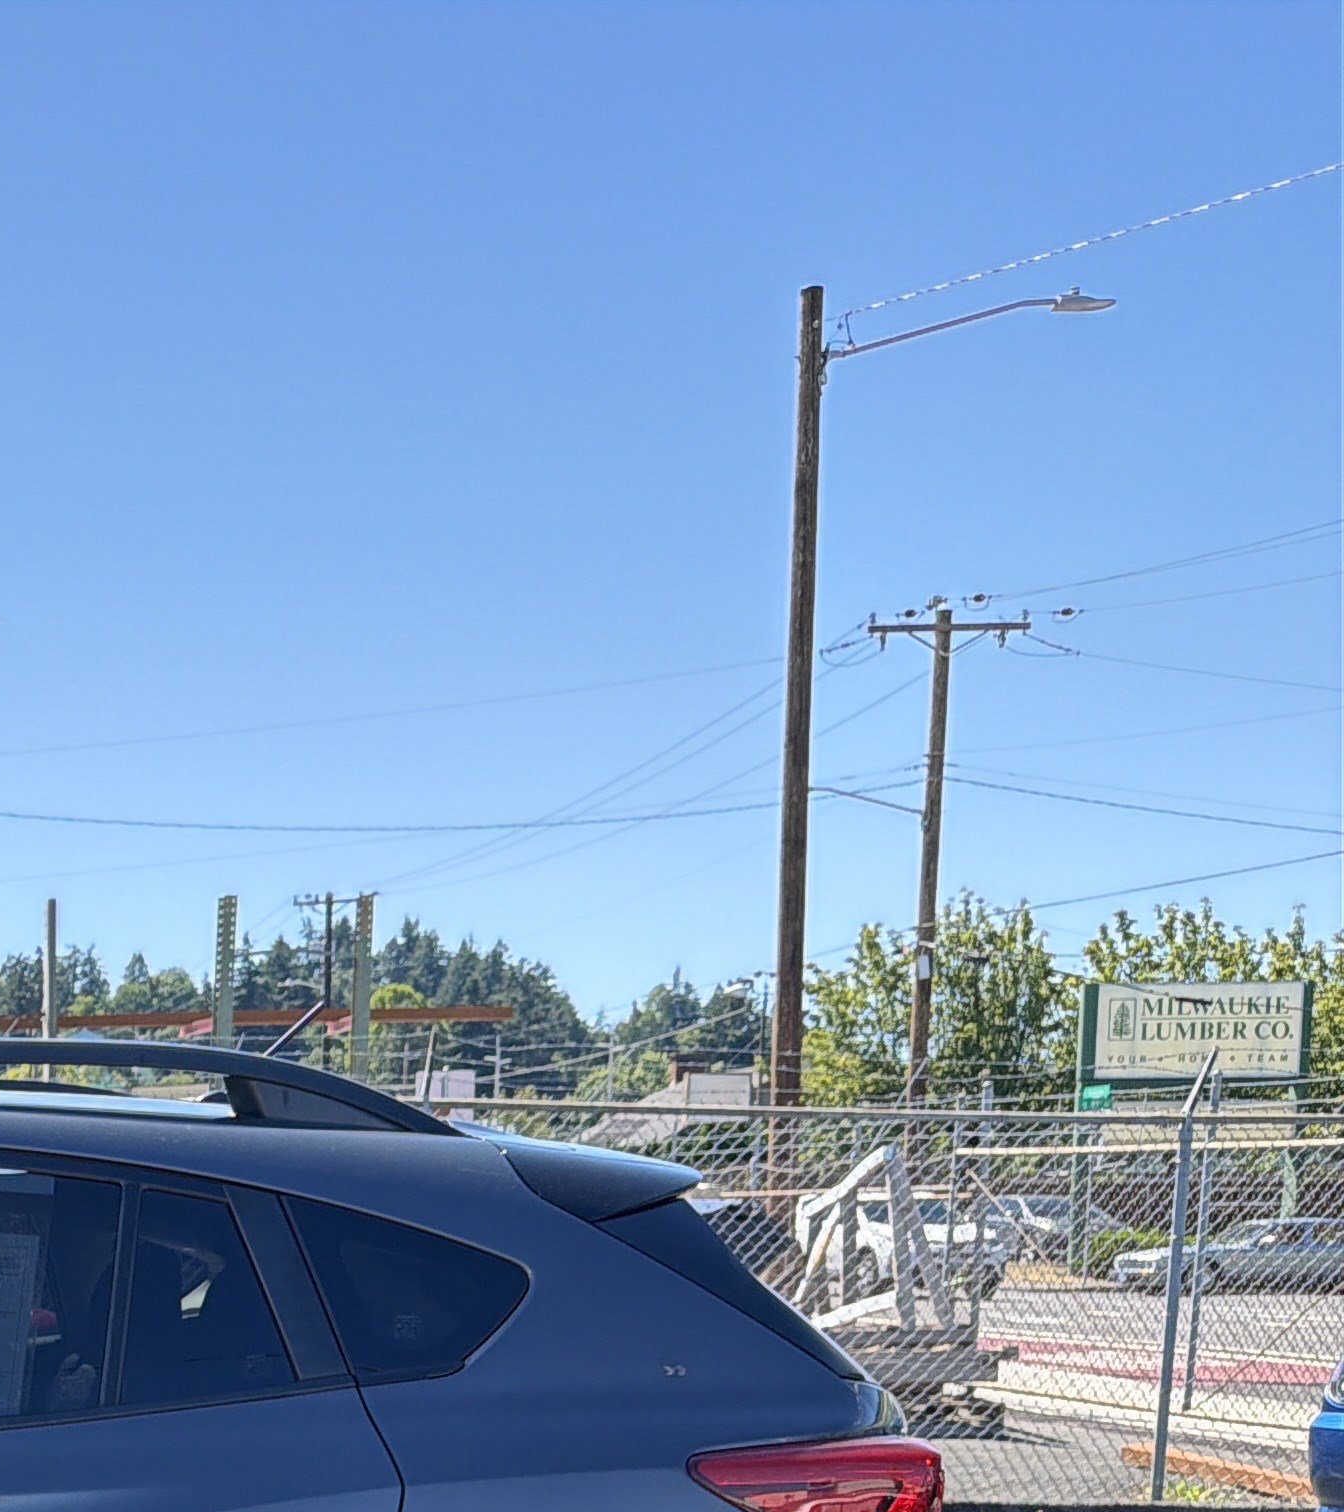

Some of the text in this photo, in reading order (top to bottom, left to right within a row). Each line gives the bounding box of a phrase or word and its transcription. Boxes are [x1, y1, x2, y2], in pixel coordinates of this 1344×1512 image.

[1141, 995, 1290, 1016] MILWAUKIE
[1141, 1020, 1294, 1041] LUMBER CO.
[1247, 1054, 1289, 1063] TEAM
